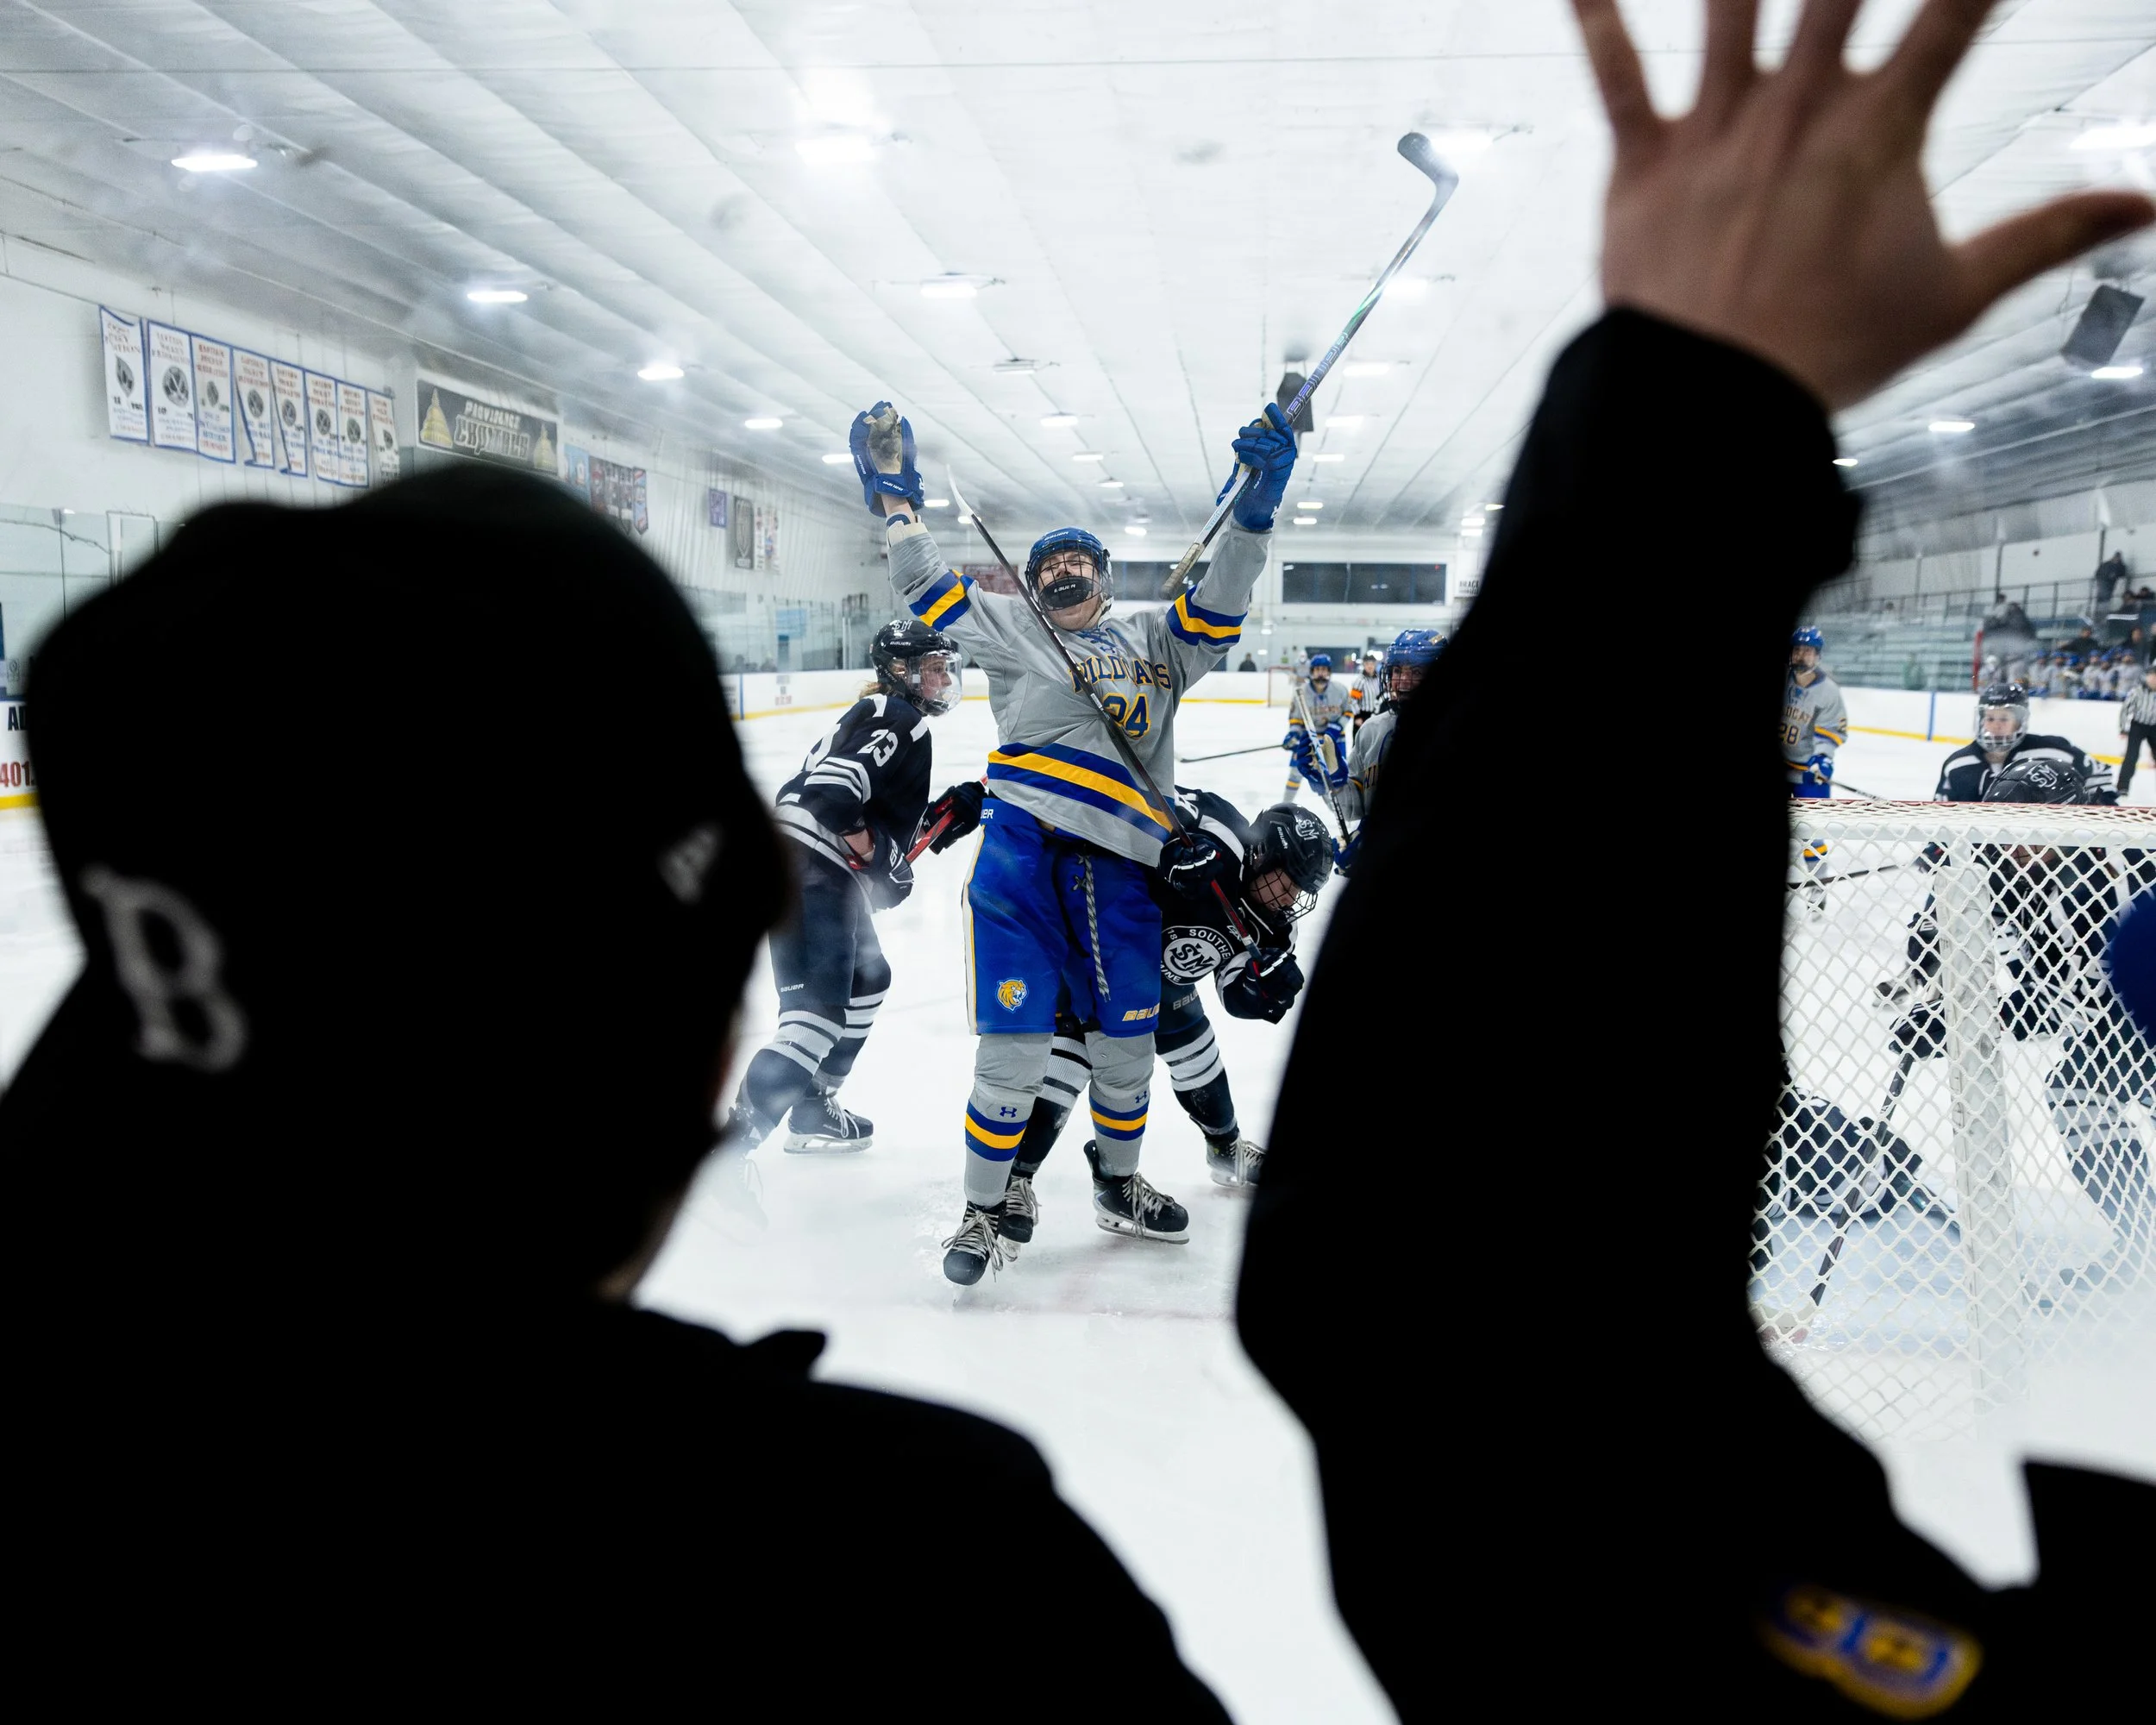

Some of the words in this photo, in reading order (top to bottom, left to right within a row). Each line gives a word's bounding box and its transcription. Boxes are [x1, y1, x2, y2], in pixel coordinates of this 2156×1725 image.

[1068, 655, 1173, 693] WILDATS
[1103, 693, 1151, 740] 24
[856, 729, 899, 767] 23
[1188, 928, 1233, 961] SOUTHE
[80, 865, 247, 1070] B
[1122, 1002, 1160, 1021] BAU
[1173, 989, 1199, 1011] BAU
